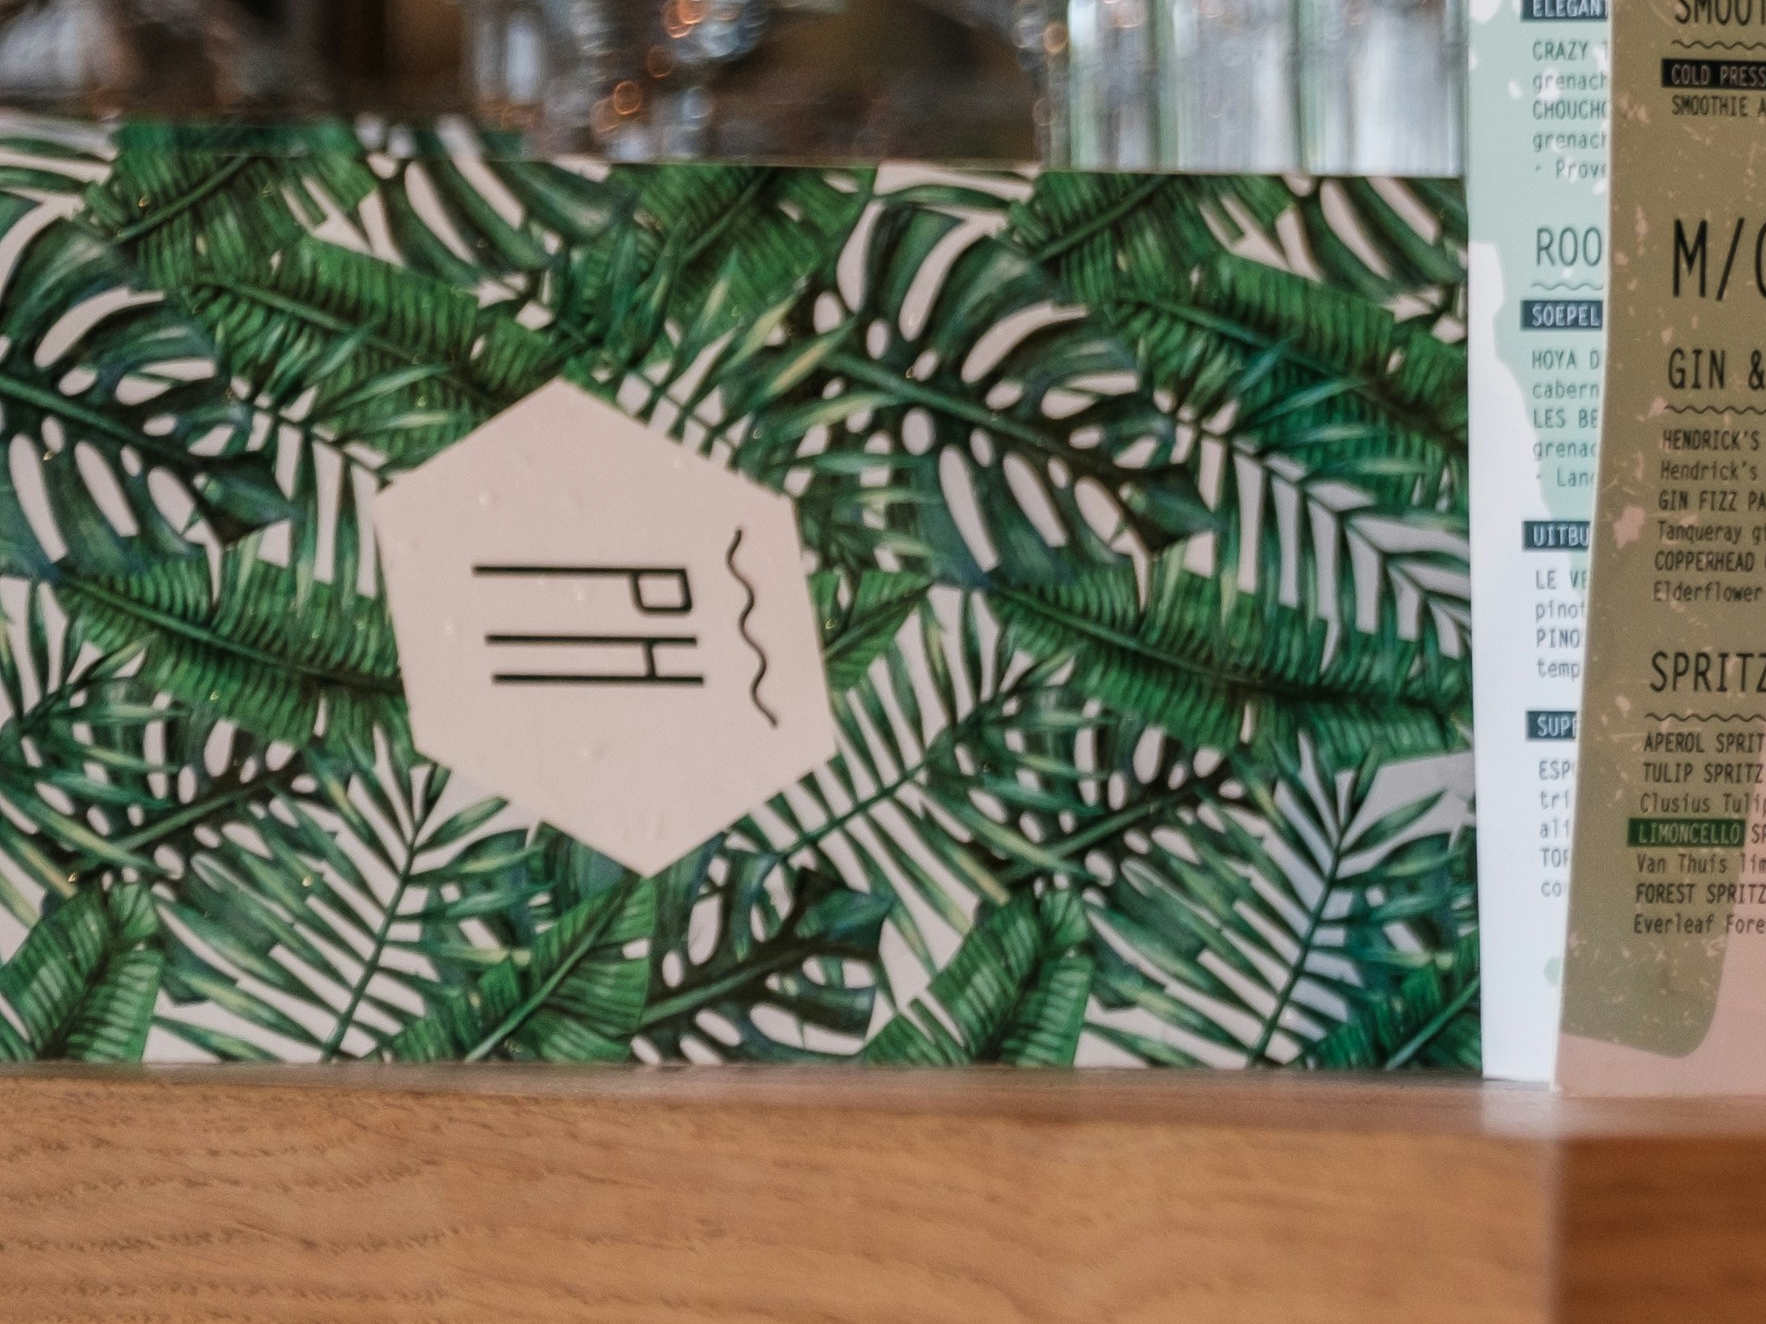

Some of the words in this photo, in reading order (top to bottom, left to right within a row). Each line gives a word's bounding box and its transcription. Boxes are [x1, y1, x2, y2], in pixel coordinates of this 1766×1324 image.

[1532, 40, 1589, 60] CRAZY
[1670, 64, 1711, 85] COLD
[1671, 94, 1749, 116] SMOOTHIE
[1536, 226, 1603, 266] ROO
[1531, 302, 1601, 326] SOEPEL
[1532, 349, 1577, 369] HOYA
[1668, 347, 1726, 389] GIN
[1748, 349, 1766, 390] &
[1662, 429, 1760, 451] HENDRICK'S
[1660, 460, 1758, 482] Hendrick's
[1658, 490, 1689, 510] GIN
[1699, 490, 1738, 512] FIZZ
[1657, 520, 1743, 544] Tanqueray
[1654, 550, 1755, 572] COPPERHEAD
[1653, 580, 1763, 601] Elderflower
[1643, 731, 1705, 752] APEROL
[1643, 761, 1694, 783] TULIP
[1704, 762, 1765, 784] SPRITZ
[1638, 822, 1741, 844] LIMONCELLO
[1635, 882, 1696, 904] FOREST
[1706, 883, 1766, 905] SPRITZ
